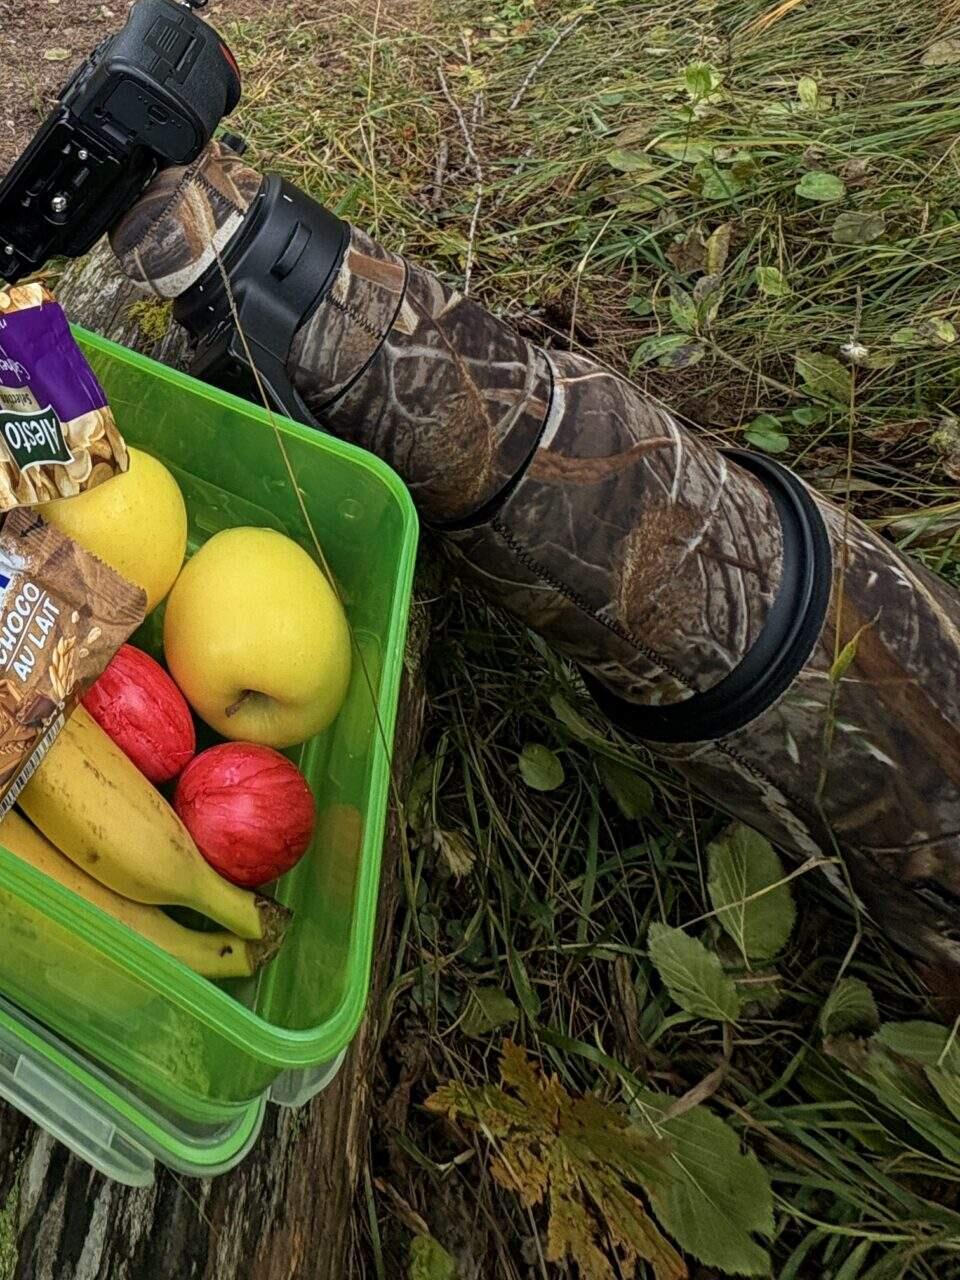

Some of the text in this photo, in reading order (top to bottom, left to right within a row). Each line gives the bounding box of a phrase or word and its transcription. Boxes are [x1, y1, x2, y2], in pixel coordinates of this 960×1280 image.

[4, 418, 61, 455] Alesto
[11, 597, 61, 682] AU LAIT
